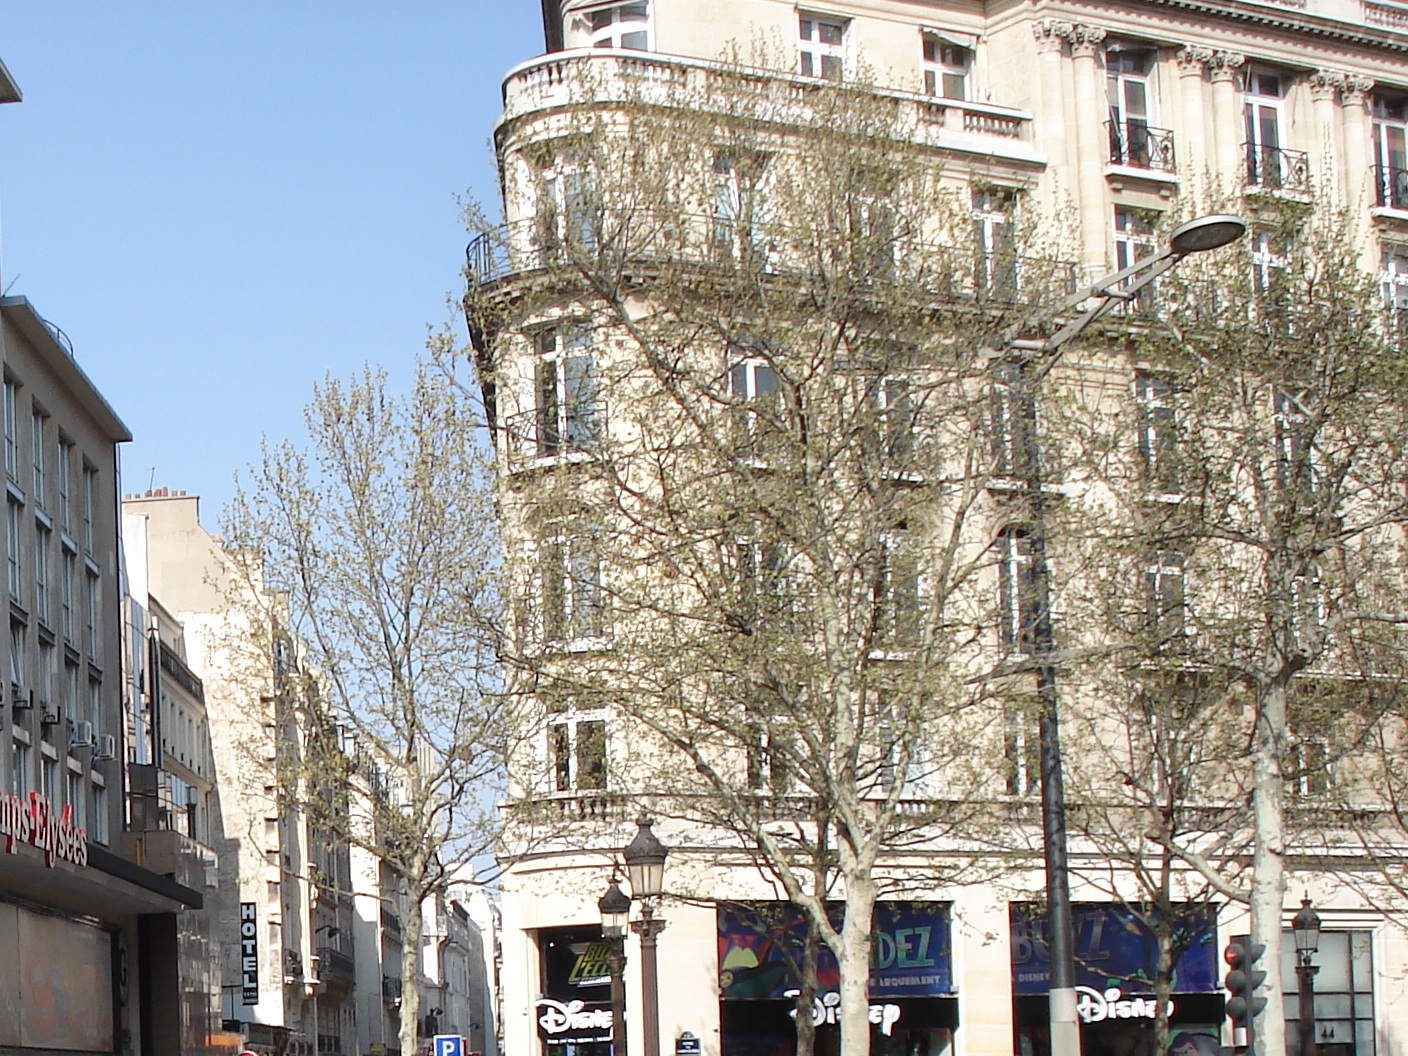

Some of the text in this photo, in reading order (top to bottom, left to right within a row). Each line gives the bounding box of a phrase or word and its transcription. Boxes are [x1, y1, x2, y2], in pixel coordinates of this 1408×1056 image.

[241, 904, 256, 989] HOTEL
[582, 943, 612, 962] BU
[871, 926, 935, 969] DEZ
[535, 998, 613, 1039] Disne
[1321, 1026, 1334, 1039] 44
